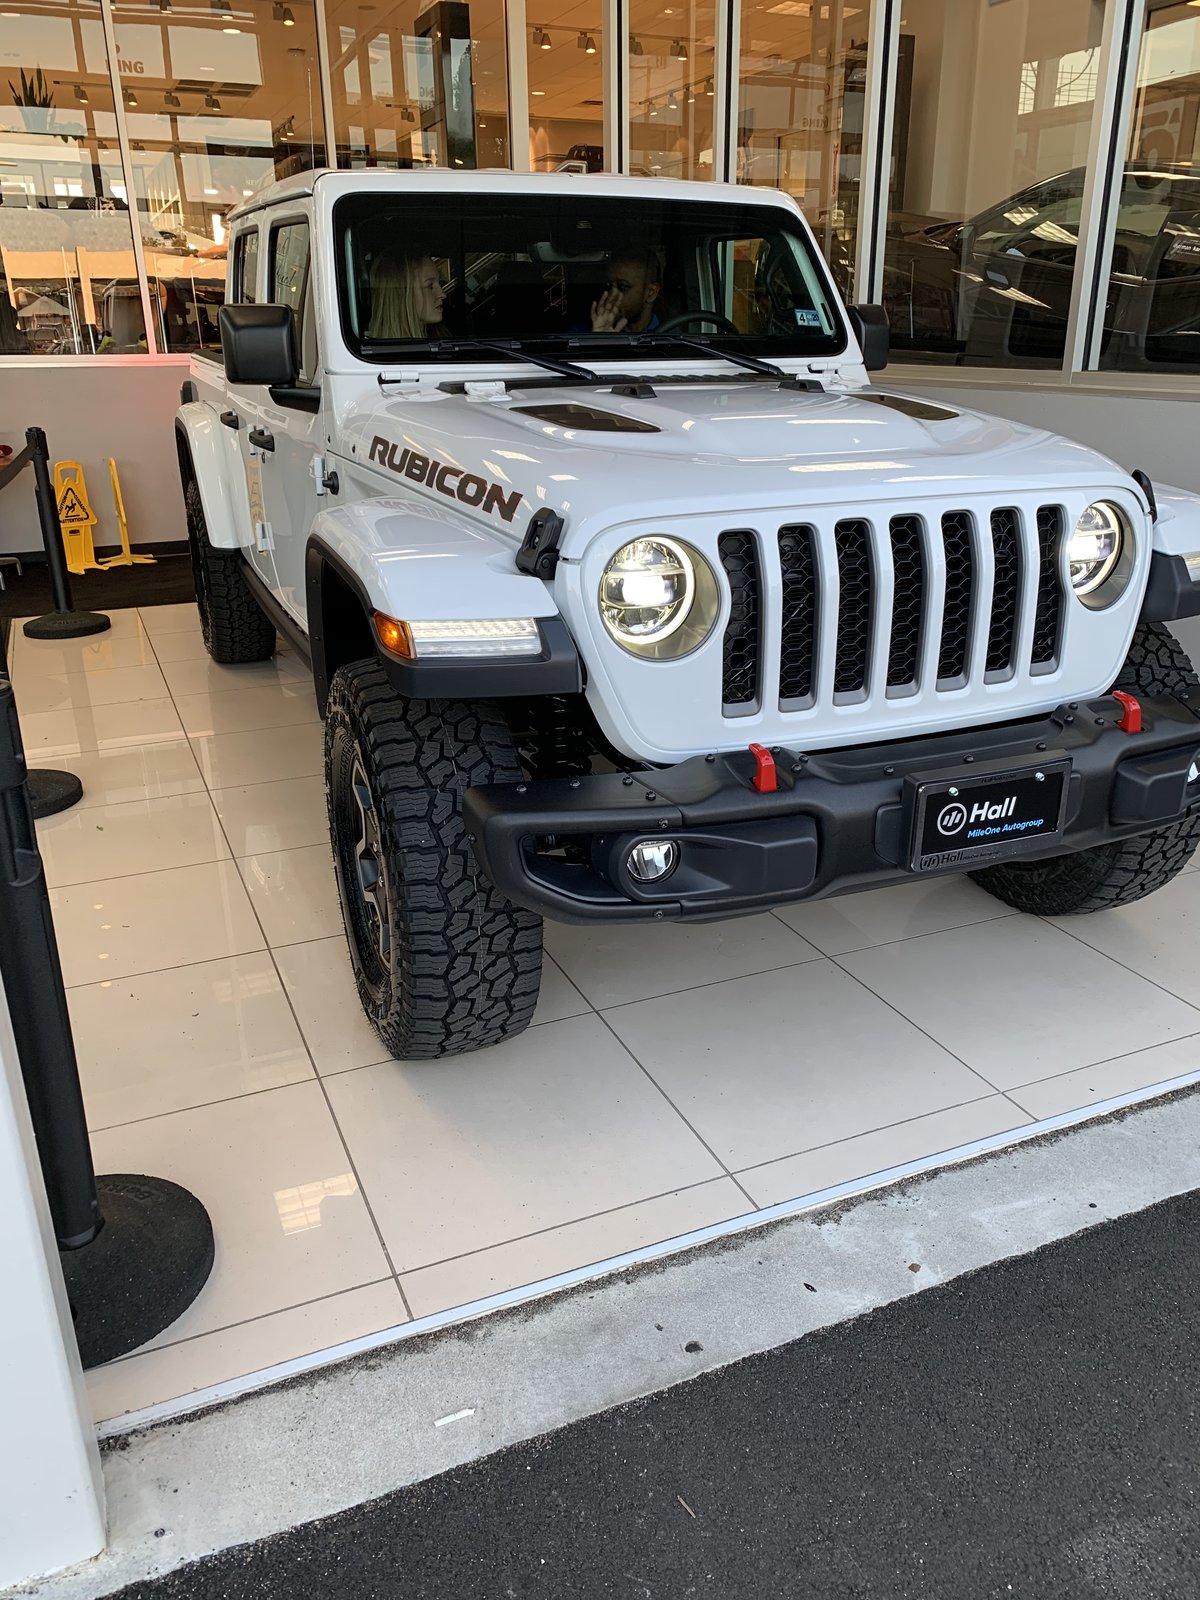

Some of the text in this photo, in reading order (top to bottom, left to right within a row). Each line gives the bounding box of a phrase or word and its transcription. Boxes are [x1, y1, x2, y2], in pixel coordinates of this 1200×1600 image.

[369, 436, 523, 523] RUBICON
[969, 796, 1017, 823] Hall
[967, 818, 1044, 838] MileOne Autogroup
[941, 851, 963, 864] Hall
